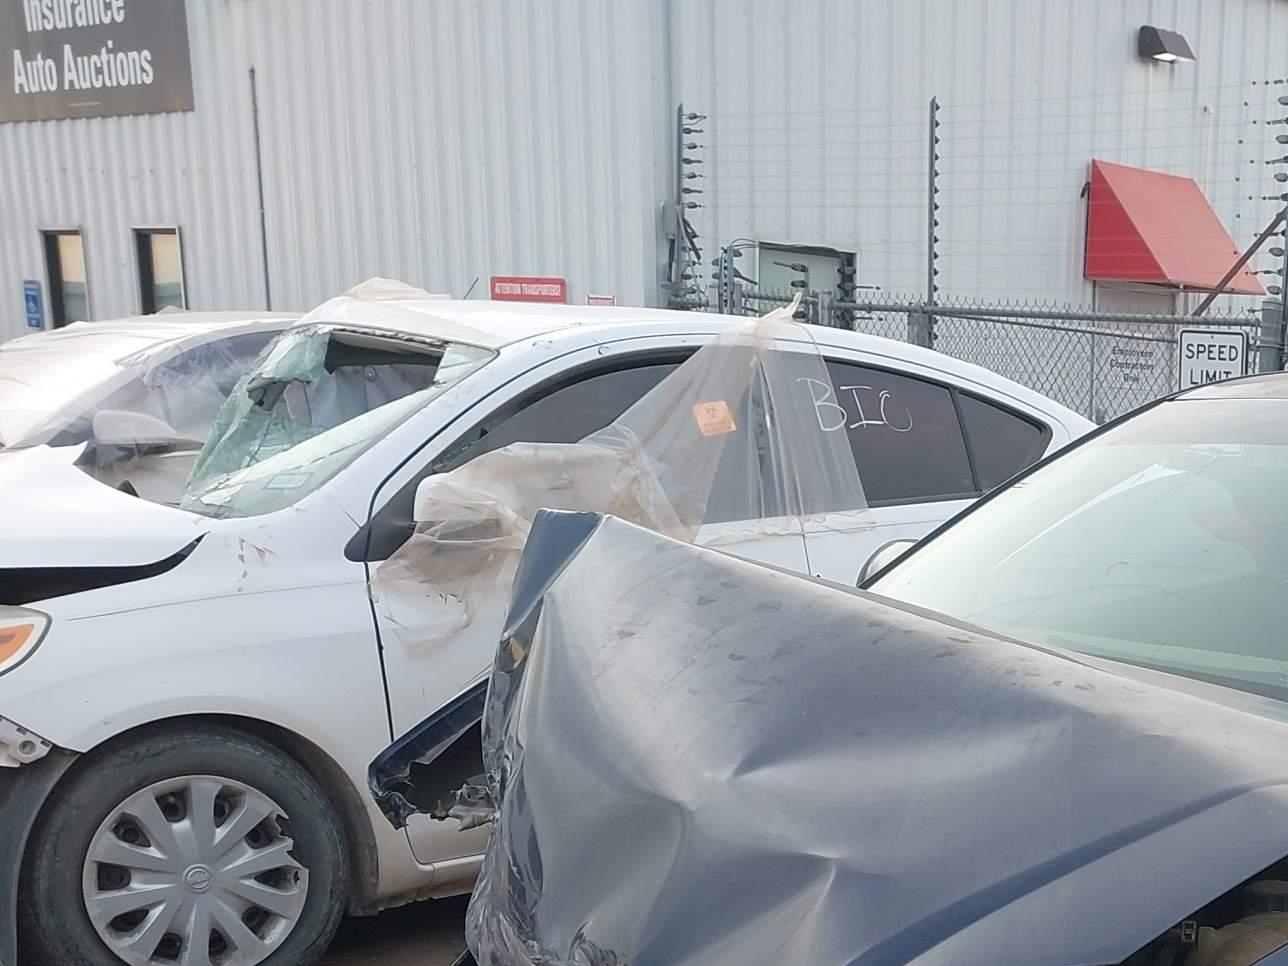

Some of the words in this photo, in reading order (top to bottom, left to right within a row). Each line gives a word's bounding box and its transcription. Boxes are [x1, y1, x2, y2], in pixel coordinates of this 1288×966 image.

[24, 0, 125, 32] Insurance
[13, 50, 57, 93] Auto
[63, 40, 154, 90] Auctions
[1185, 343, 1239, 362] SPEED
